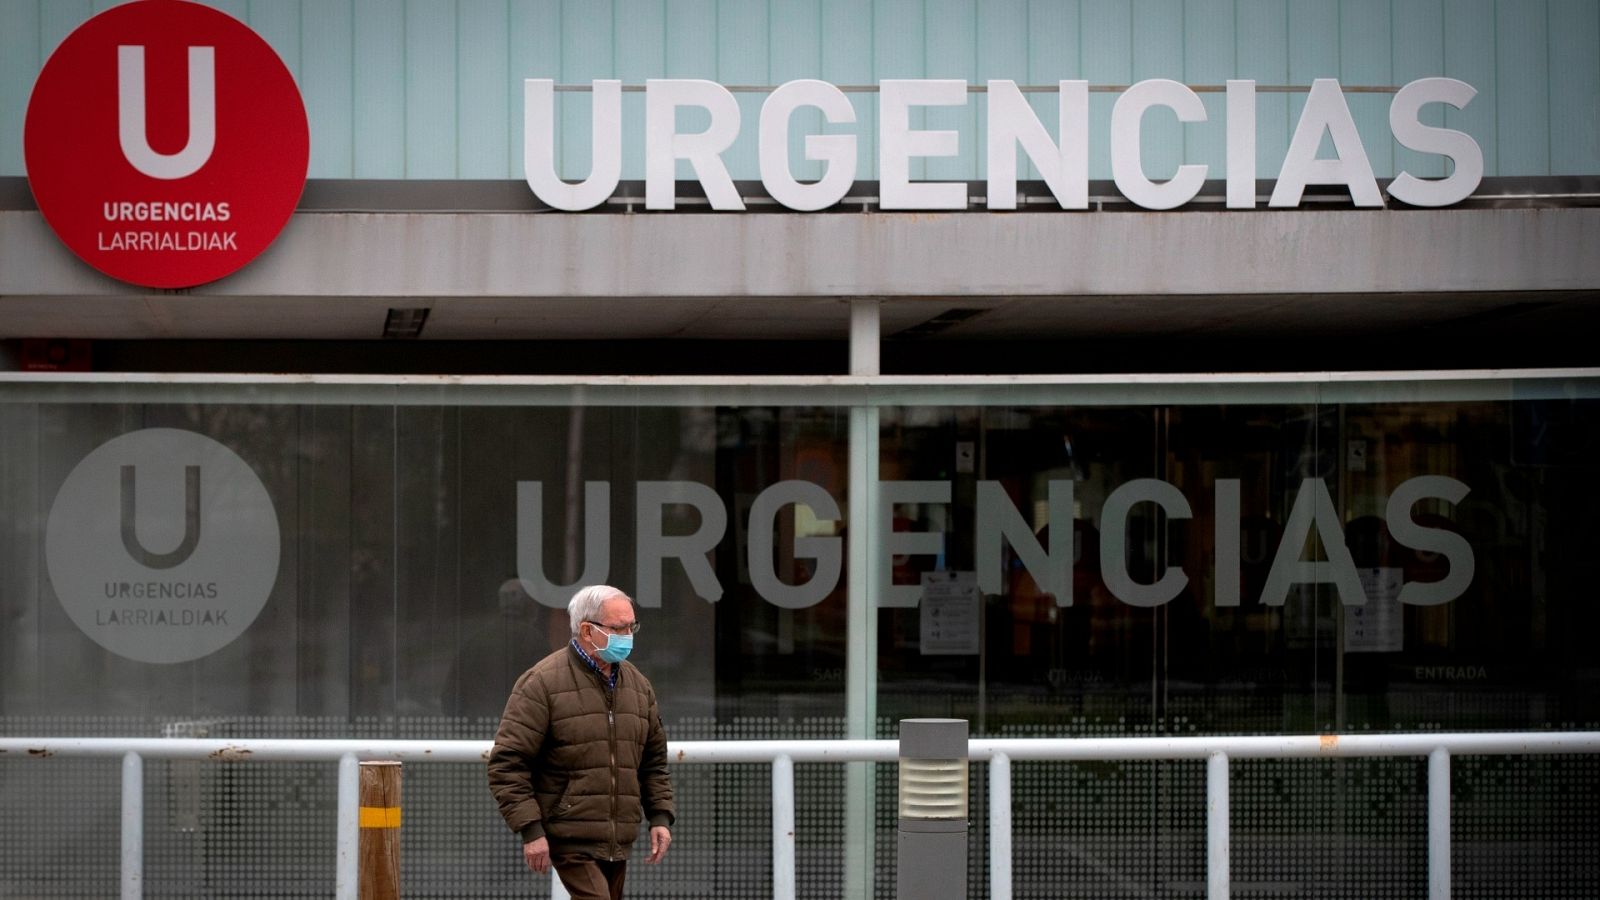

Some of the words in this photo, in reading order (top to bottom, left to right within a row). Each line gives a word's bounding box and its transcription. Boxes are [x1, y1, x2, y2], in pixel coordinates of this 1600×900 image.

[117, 44, 216, 180] U
[524, 77, 1484, 211] URGENCIAS
[103, 202, 231, 222] URGENCIAS
[97, 231, 238, 251] LARRIALDIAK
[120, 465, 201, 570] U
[516, 474, 1475, 609] URGENCIAS
[104, 582, 217, 599] URGENCIAS
[96, 609, 228, 626] LARRIALDIAK
[1414, 665, 1488, 680] ENTRADA
